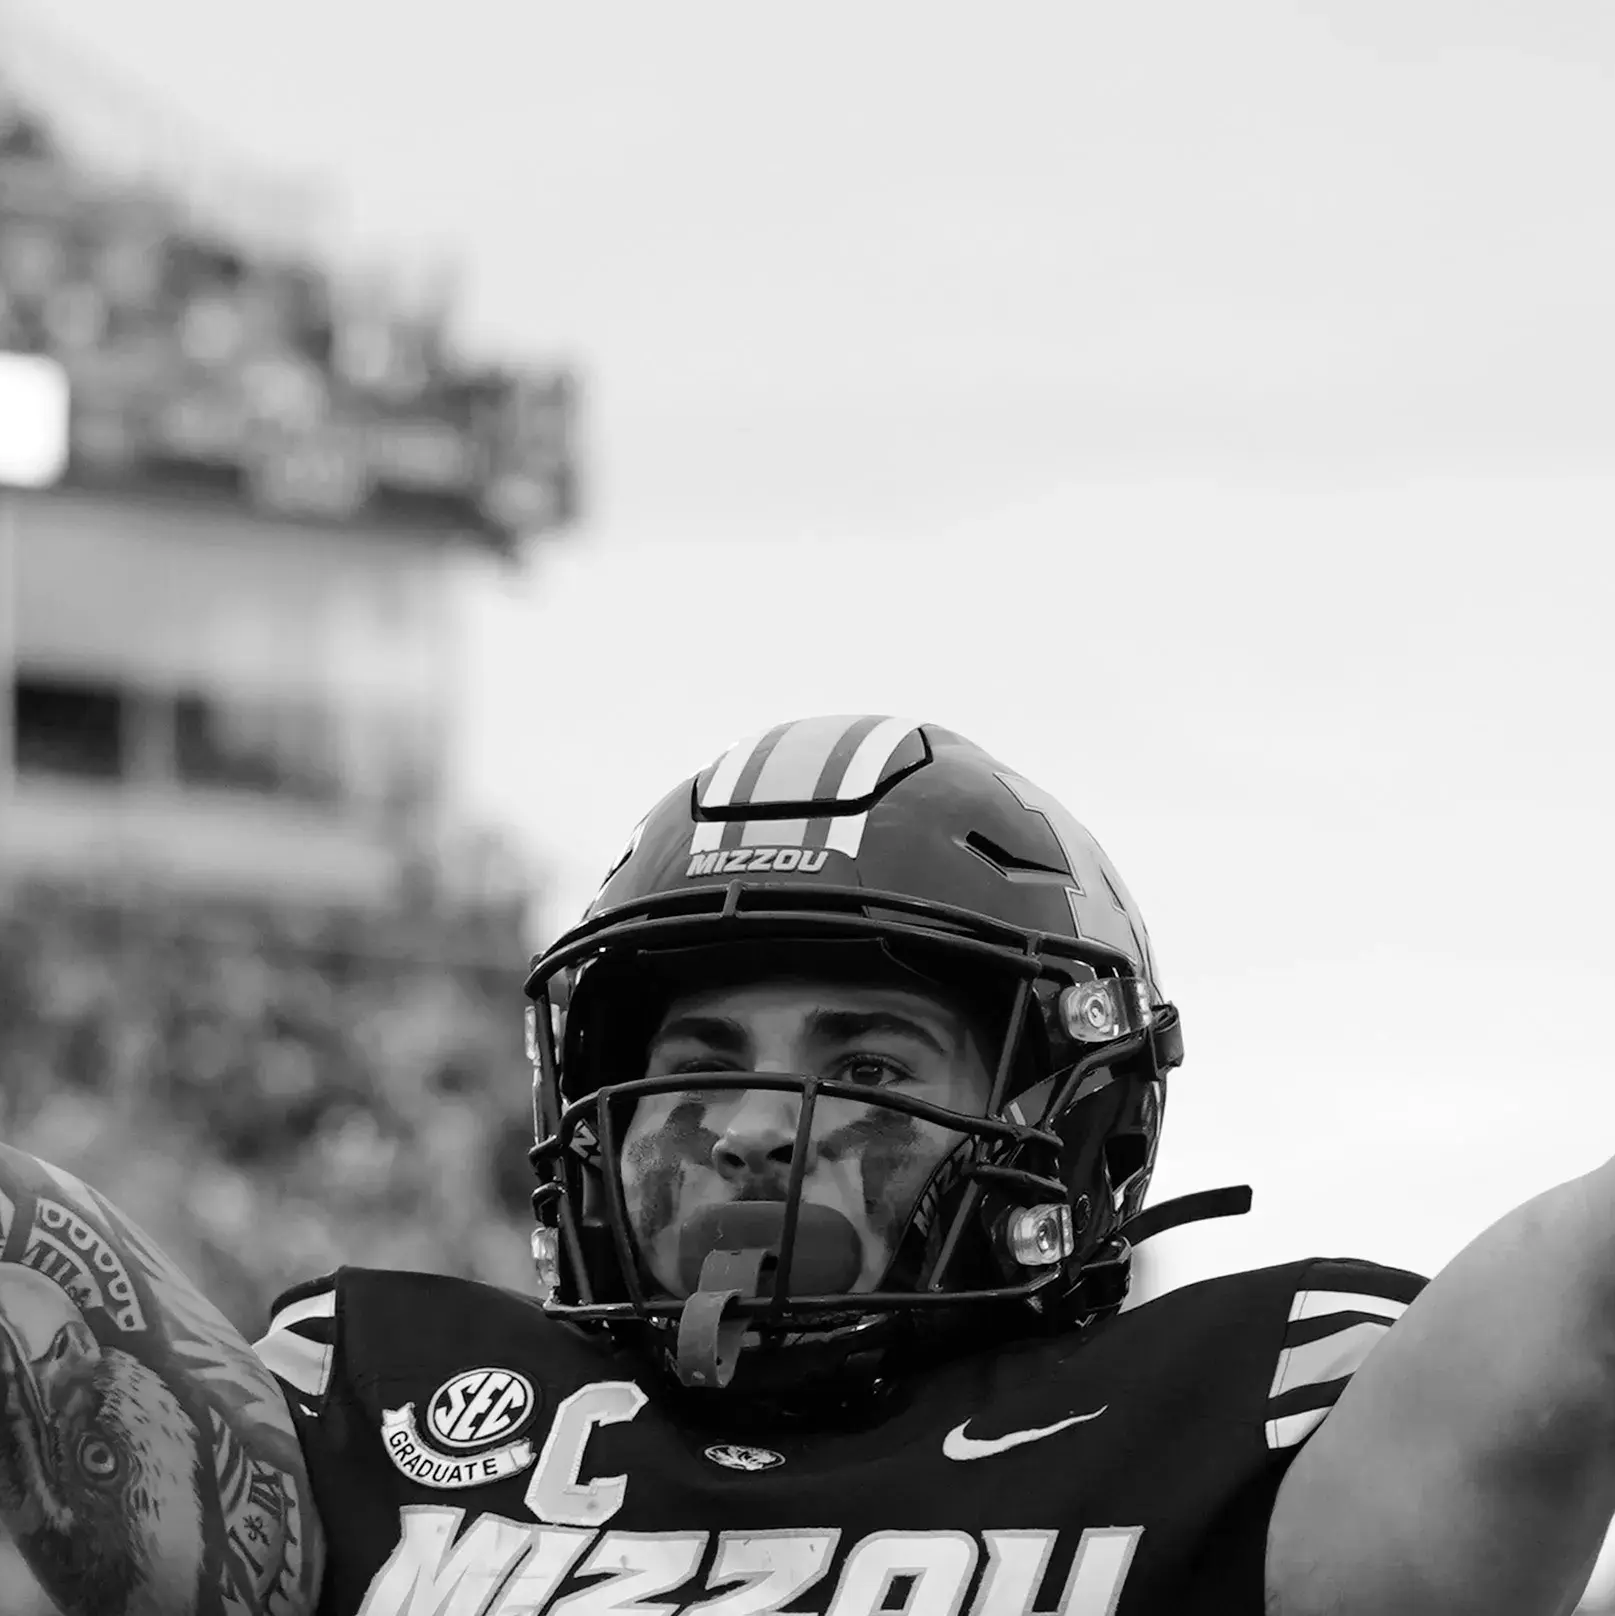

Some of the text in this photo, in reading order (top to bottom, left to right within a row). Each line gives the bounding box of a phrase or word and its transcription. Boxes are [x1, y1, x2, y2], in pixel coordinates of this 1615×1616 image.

[685, 848, 830, 878] MIZZOU
[435, 1371, 526, 1441] SEC
[389, 1430, 498, 1483] GRADUATE
[523, 1380, 650, 1527] C
